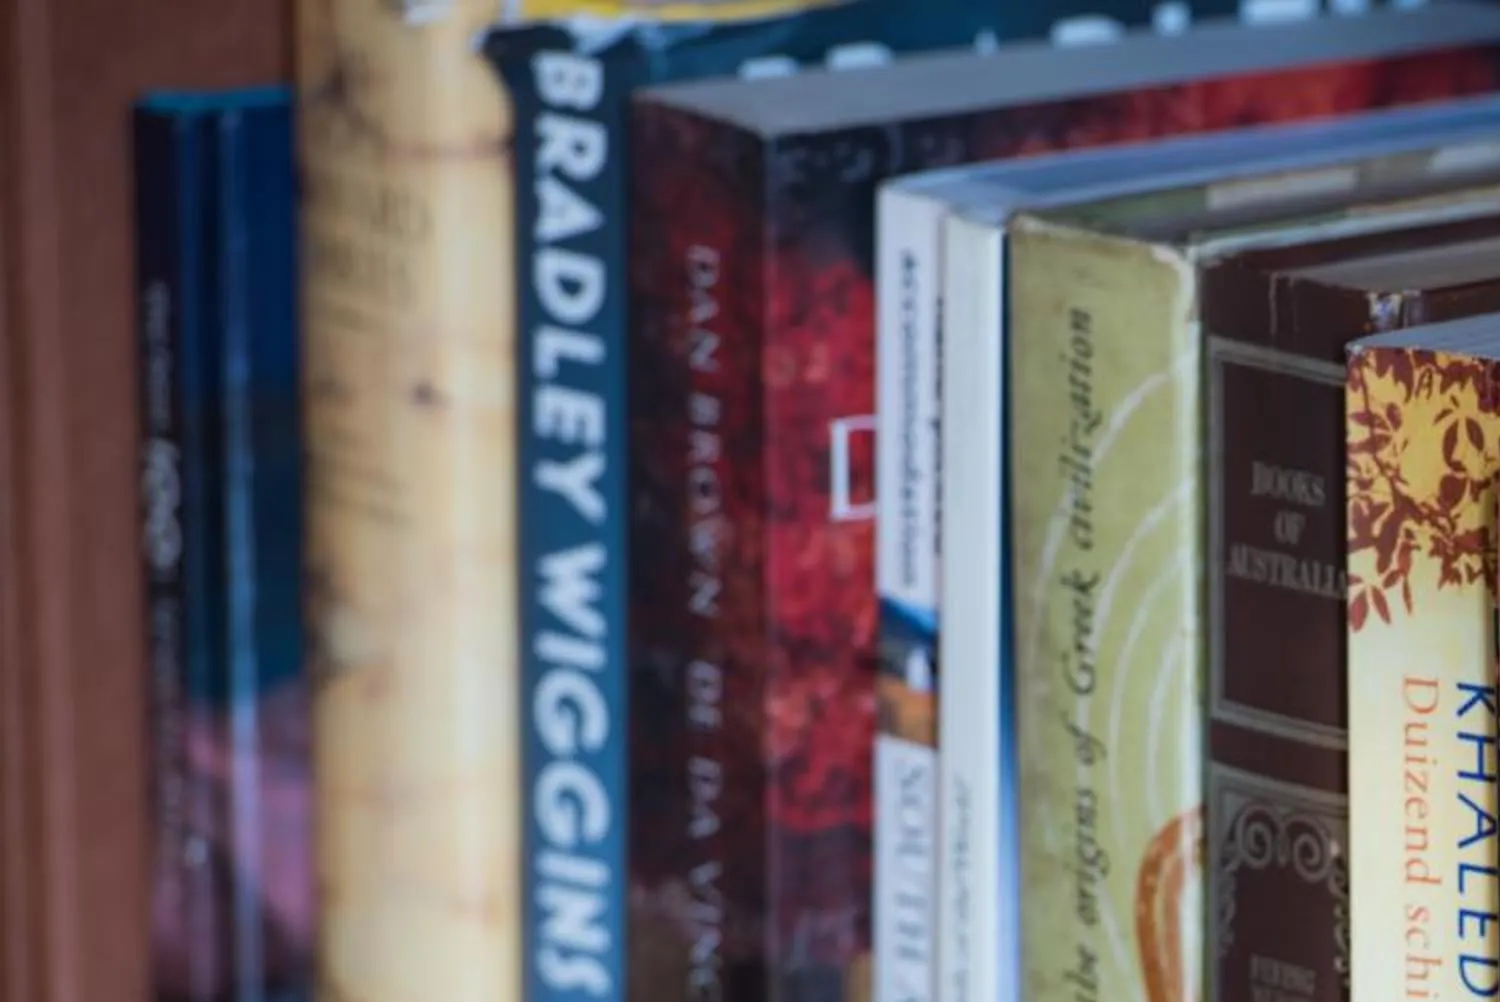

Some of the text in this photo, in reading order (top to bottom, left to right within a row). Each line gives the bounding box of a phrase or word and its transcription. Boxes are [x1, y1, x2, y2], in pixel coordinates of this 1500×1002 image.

[686, 244, 722, 373] DAN
[1056, 306, 1103, 551] civilization
[531, 50, 611, 997] BRADLEY WIGGINS
[686, 392, 723, 619] BROWN
[1062, 569, 1103, 698] Greek
[686, 757, 723, 840] DA
[1062, 711, 1109, 766] of
[1401, 674, 1443, 888] Duizend
[1063, 787, 1111, 927] origins
